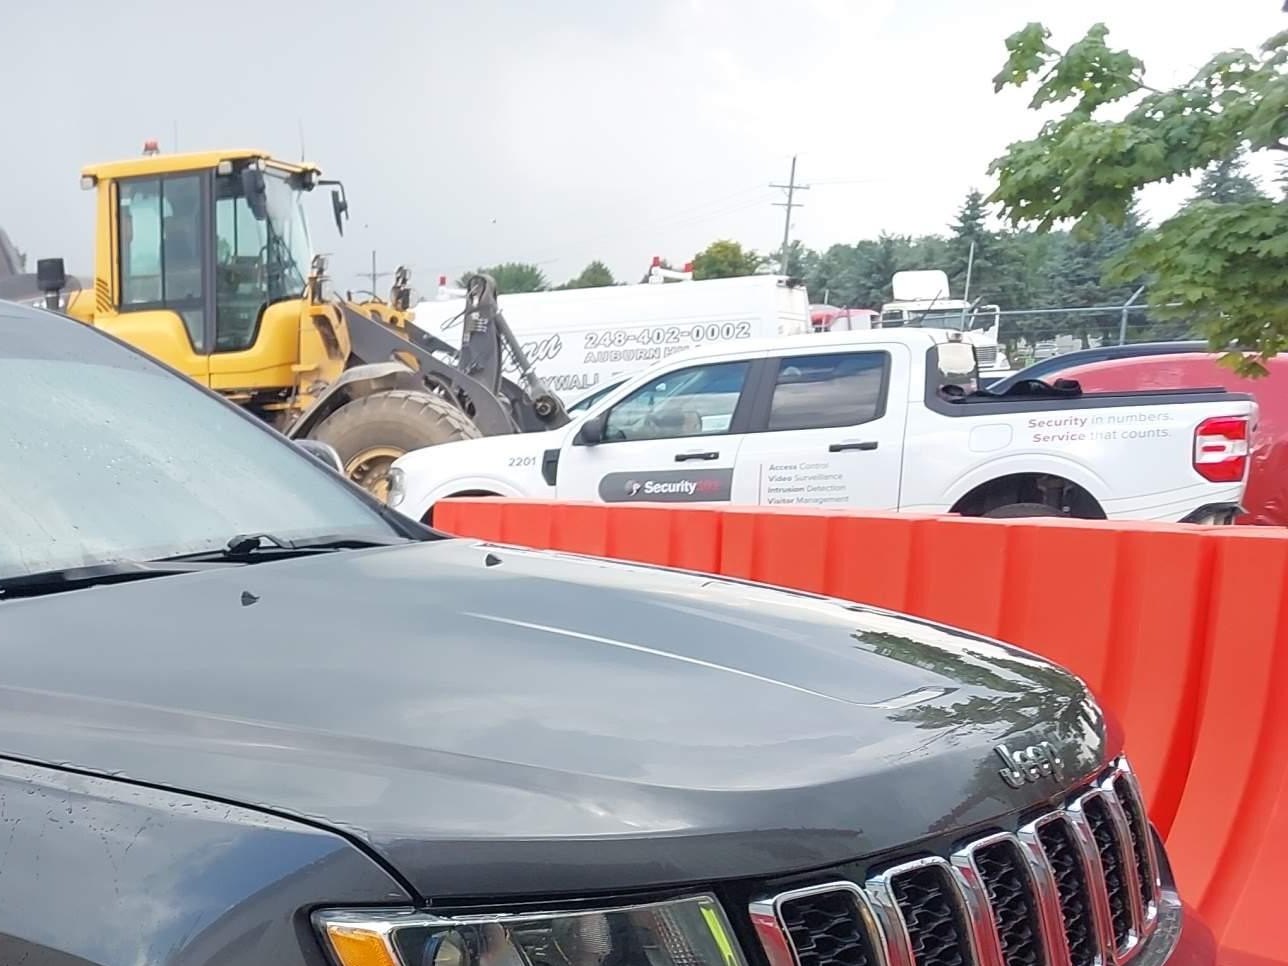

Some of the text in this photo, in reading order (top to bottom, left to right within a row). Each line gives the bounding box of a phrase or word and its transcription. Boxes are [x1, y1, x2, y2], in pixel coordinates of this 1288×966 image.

[584, 322, 751, 349] 248-402-0002
[584, 346, 662, 364] AUBURN
[1027, 411, 1174, 429] Security in numbers.
[1032, 427, 1172, 443] Service that counts.
[508, 456, 536, 467] 2201
[768, 462, 829, 471] Access Control
[768, 474, 792, 482] Video
[767, 484, 846, 494] Intrusion Detection
[767, 497, 794, 505] Visitor
[993, 741, 1065, 789] Jeep
